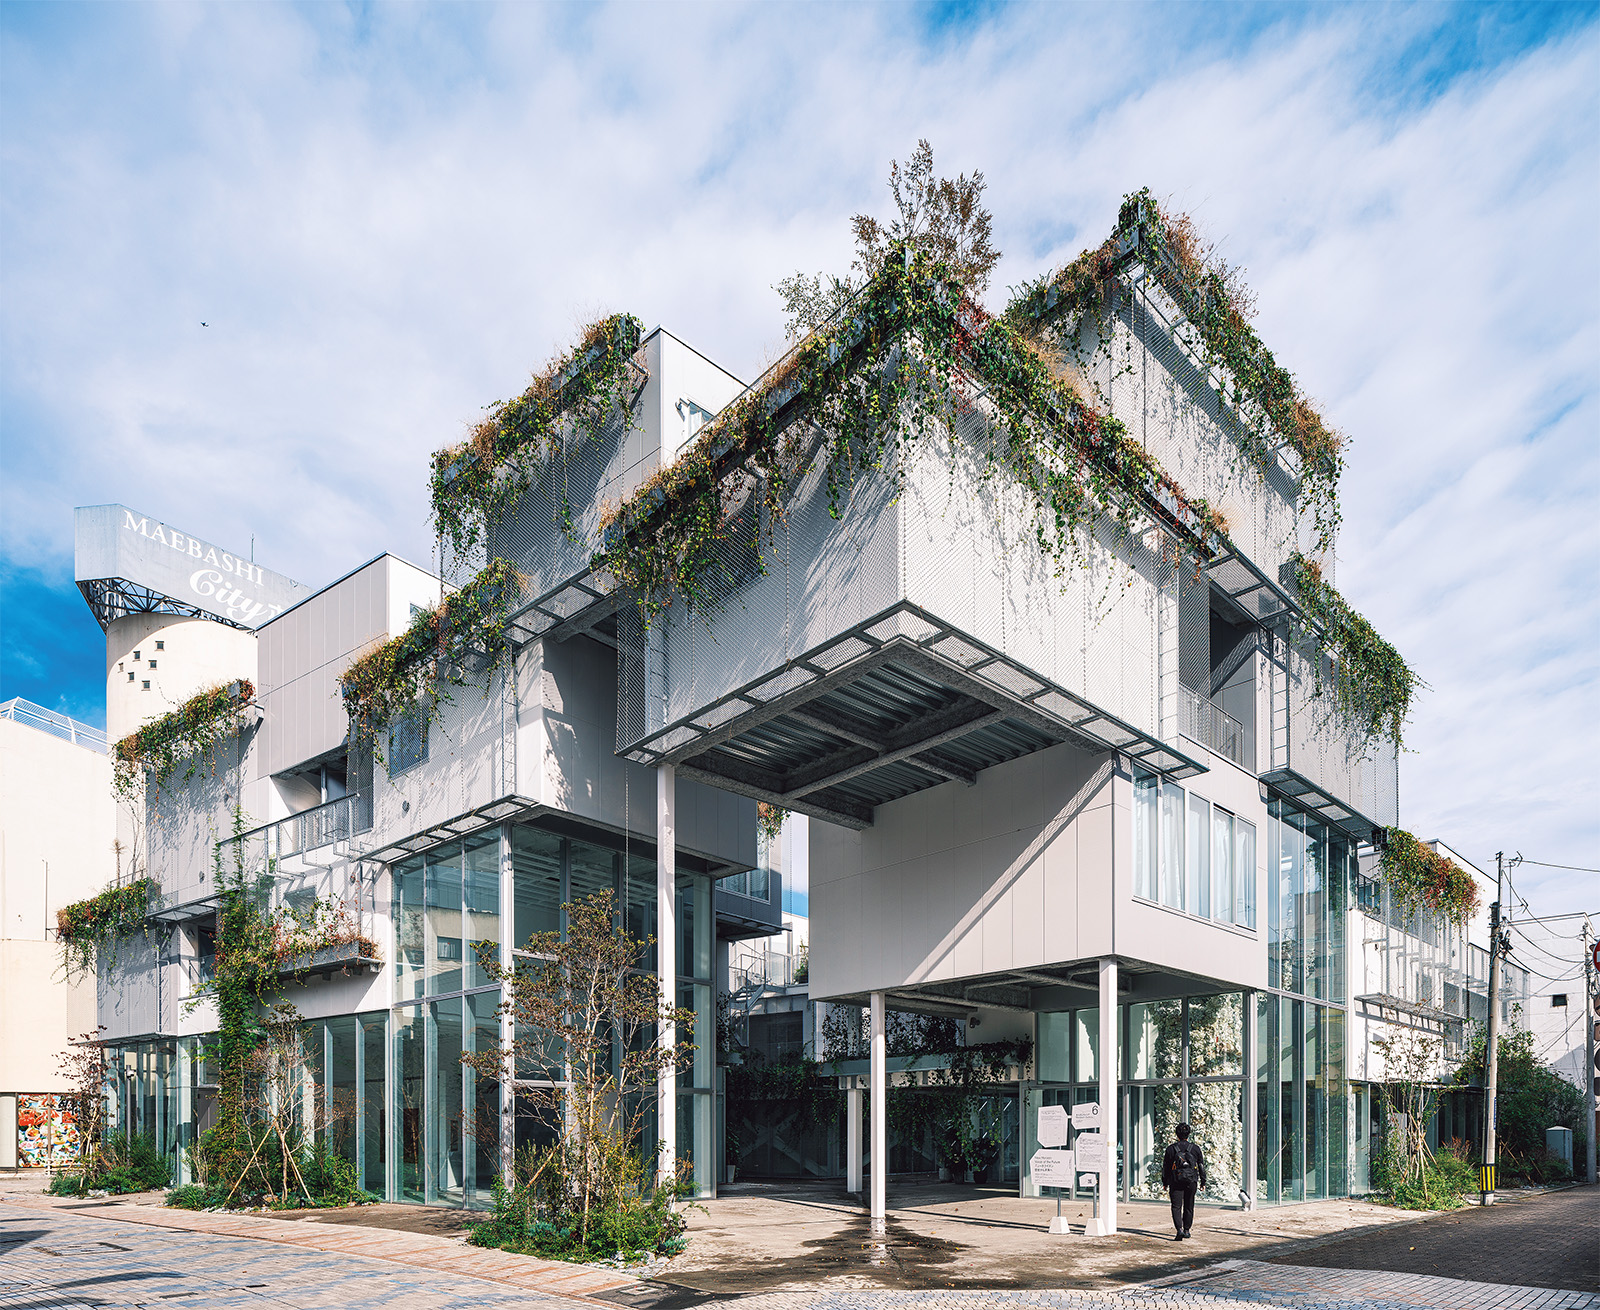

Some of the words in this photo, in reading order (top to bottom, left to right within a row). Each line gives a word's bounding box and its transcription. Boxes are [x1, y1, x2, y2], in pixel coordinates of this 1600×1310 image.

[123, 509, 264, 587] MAEBASHI
[189, 569, 268, 623] City
[1092, 1105, 1099, 1115] 6
